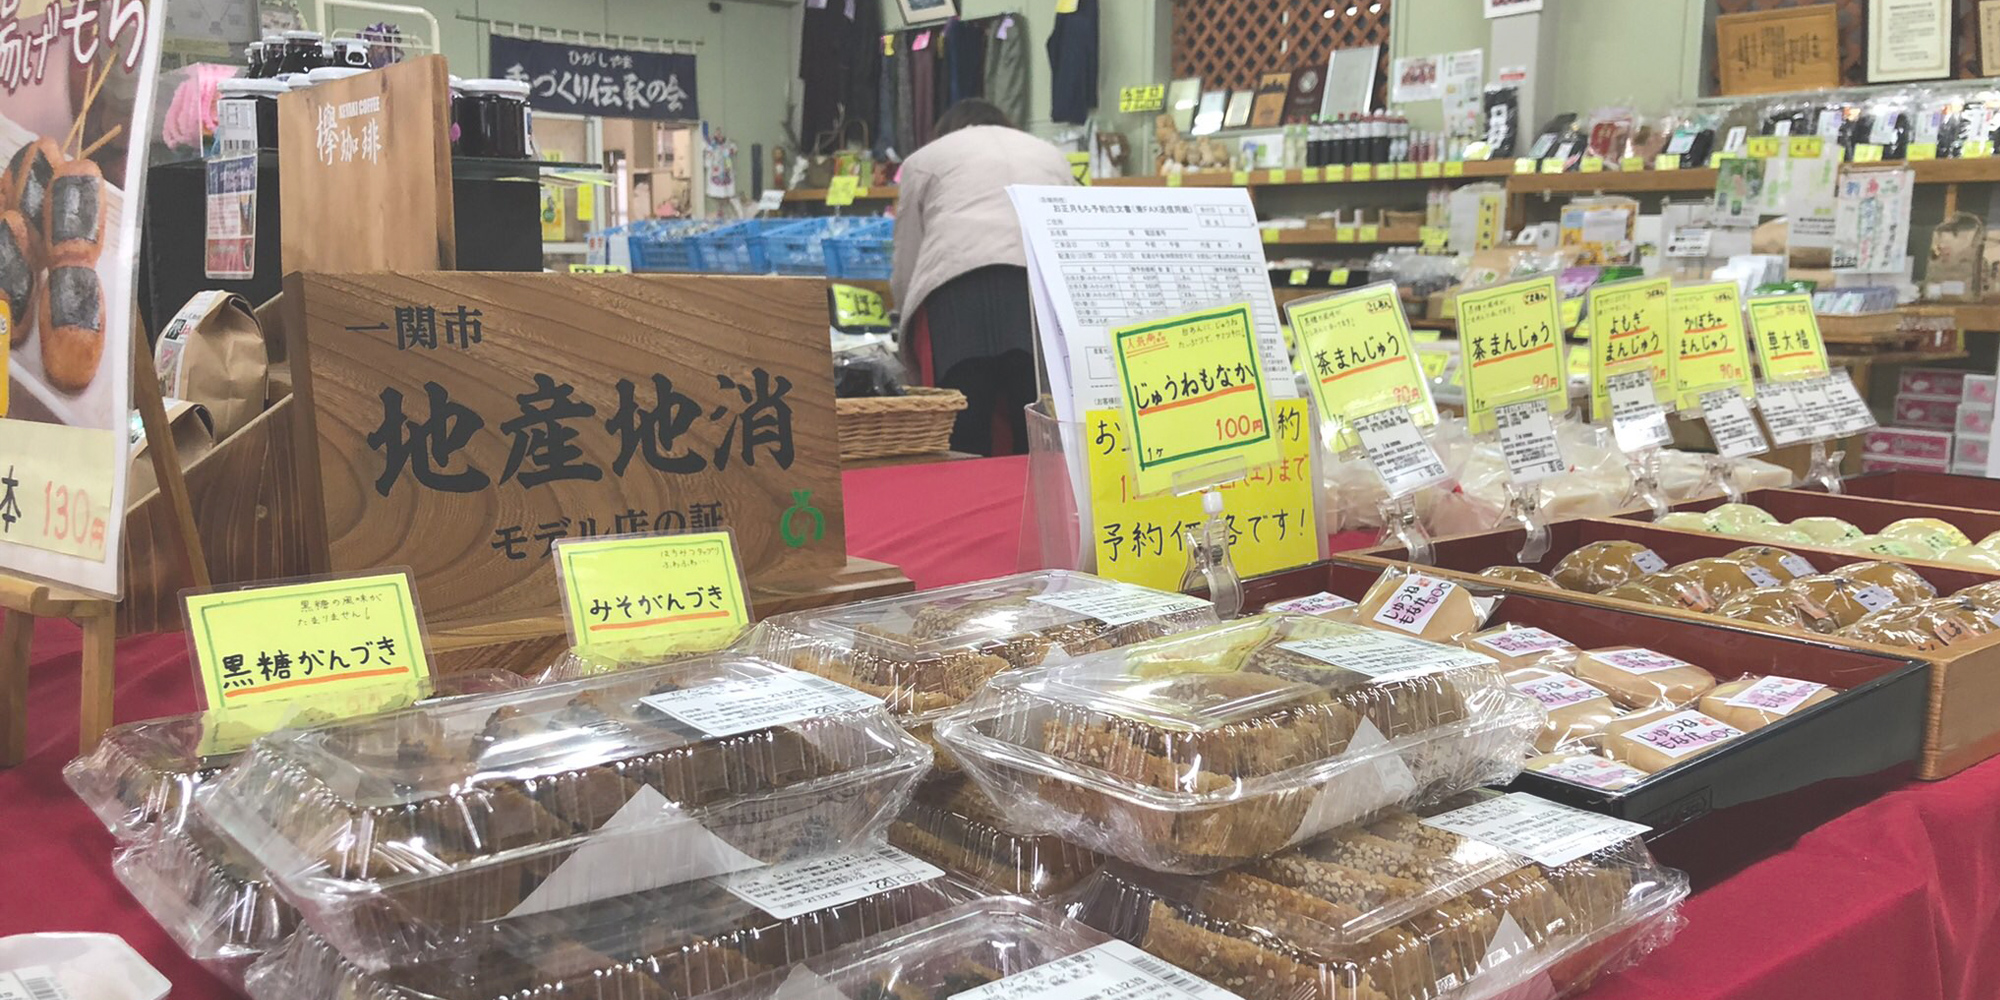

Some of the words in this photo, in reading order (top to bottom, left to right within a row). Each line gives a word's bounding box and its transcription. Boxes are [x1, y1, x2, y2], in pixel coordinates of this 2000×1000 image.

[568, 50, 634, 69] ひがしやま
[359, 96, 380, 115] COFFEE
[345, 304, 484, 351] 一関市
[1609, 308, 1645, 335] よもぎ
[1684, 311, 1723, 329] かぼちゃ
[1314, 331, 1400, 376] 茶まんじゅう
[1472, 321, 1550, 361] 茶まんじゅう
[1605, 331, 1660, 362] まんじゅう
[1680, 332, 1729, 355] まんじゅう
[1767, 329, 1811, 357] 草大福
[1133, 362, 1255, 410] じゅうねもなか
[1532, 374, 1559, 391] 90円
[1653, 365, 1667, 383] 0円
[367, 366, 796, 498] 地産地消
[1215, 414, 1264, 441] 100円
[43, 480, 106, 549] 130円
[299, 593, 384, 613] 黒糖の風味が
[589, 584, 723, 623] みそがんづき
[1383, 585, 1420, 620] じゅうね
[1398, 596, 1430, 625] もなか
[221, 635, 397, 690] 黒糖がんづき
[1520, 681, 1565, 695] ゅうね
[1535, 691, 1568, 704] なか
[1636, 718, 1699, 743] じゅうね
[1655, 731, 1704, 750] もなか
